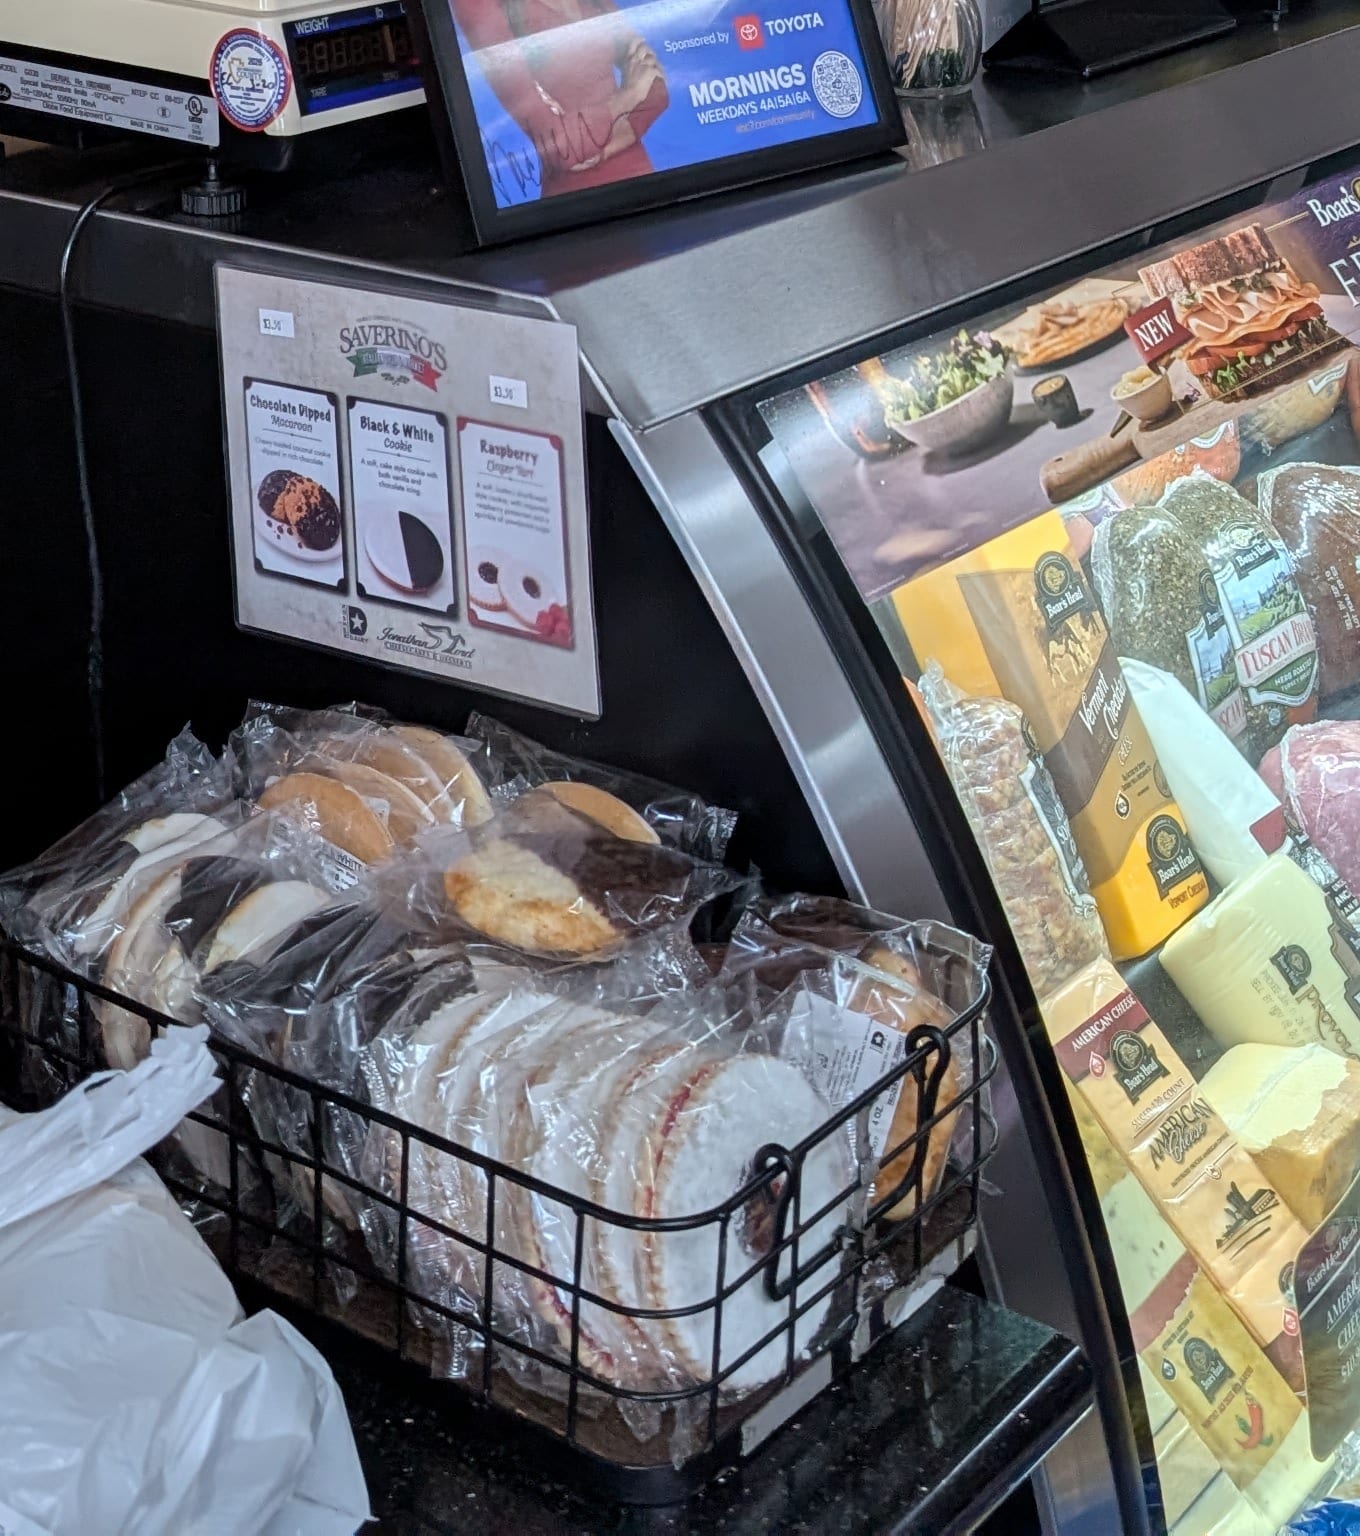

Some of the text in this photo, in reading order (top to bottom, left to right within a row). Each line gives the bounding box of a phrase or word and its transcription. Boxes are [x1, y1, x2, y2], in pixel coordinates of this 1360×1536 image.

[295, 8, 383, 35] WEIGHT lb
[764, 12, 824, 36] TOYOTA
[664, 30, 730, 53] Sponsored by
[689, 63, 807, 107] MORNINGS
[697, 98, 757, 125] WEEKDAYS
[1134, 307, 1176, 352] NEW
[340, 325, 448, 371] SAVERINO'S
[250, 394, 331, 423] Chocolate Dipped
[271, 417, 313, 433] Macaroon
[360, 416, 434, 443] Black & White
[383, 437, 413, 453] Cookie
[480, 439, 539, 465] Raspberry
[1046, 587, 1084, 619] Boar's Head
[1240, 632, 1293, 678] TUSCAN
[1078, 668, 1111, 736] Vermont
[1158, 853, 1196, 884] Boar's Head
[1072, 994, 1138, 1052] AMERICAN CHEESE
[1124, 1054, 1161, 1090] Boar's Head
[1149, 1097, 1216, 1170] AMERICAN
[1167, 1118, 1208, 1164] Cheese
